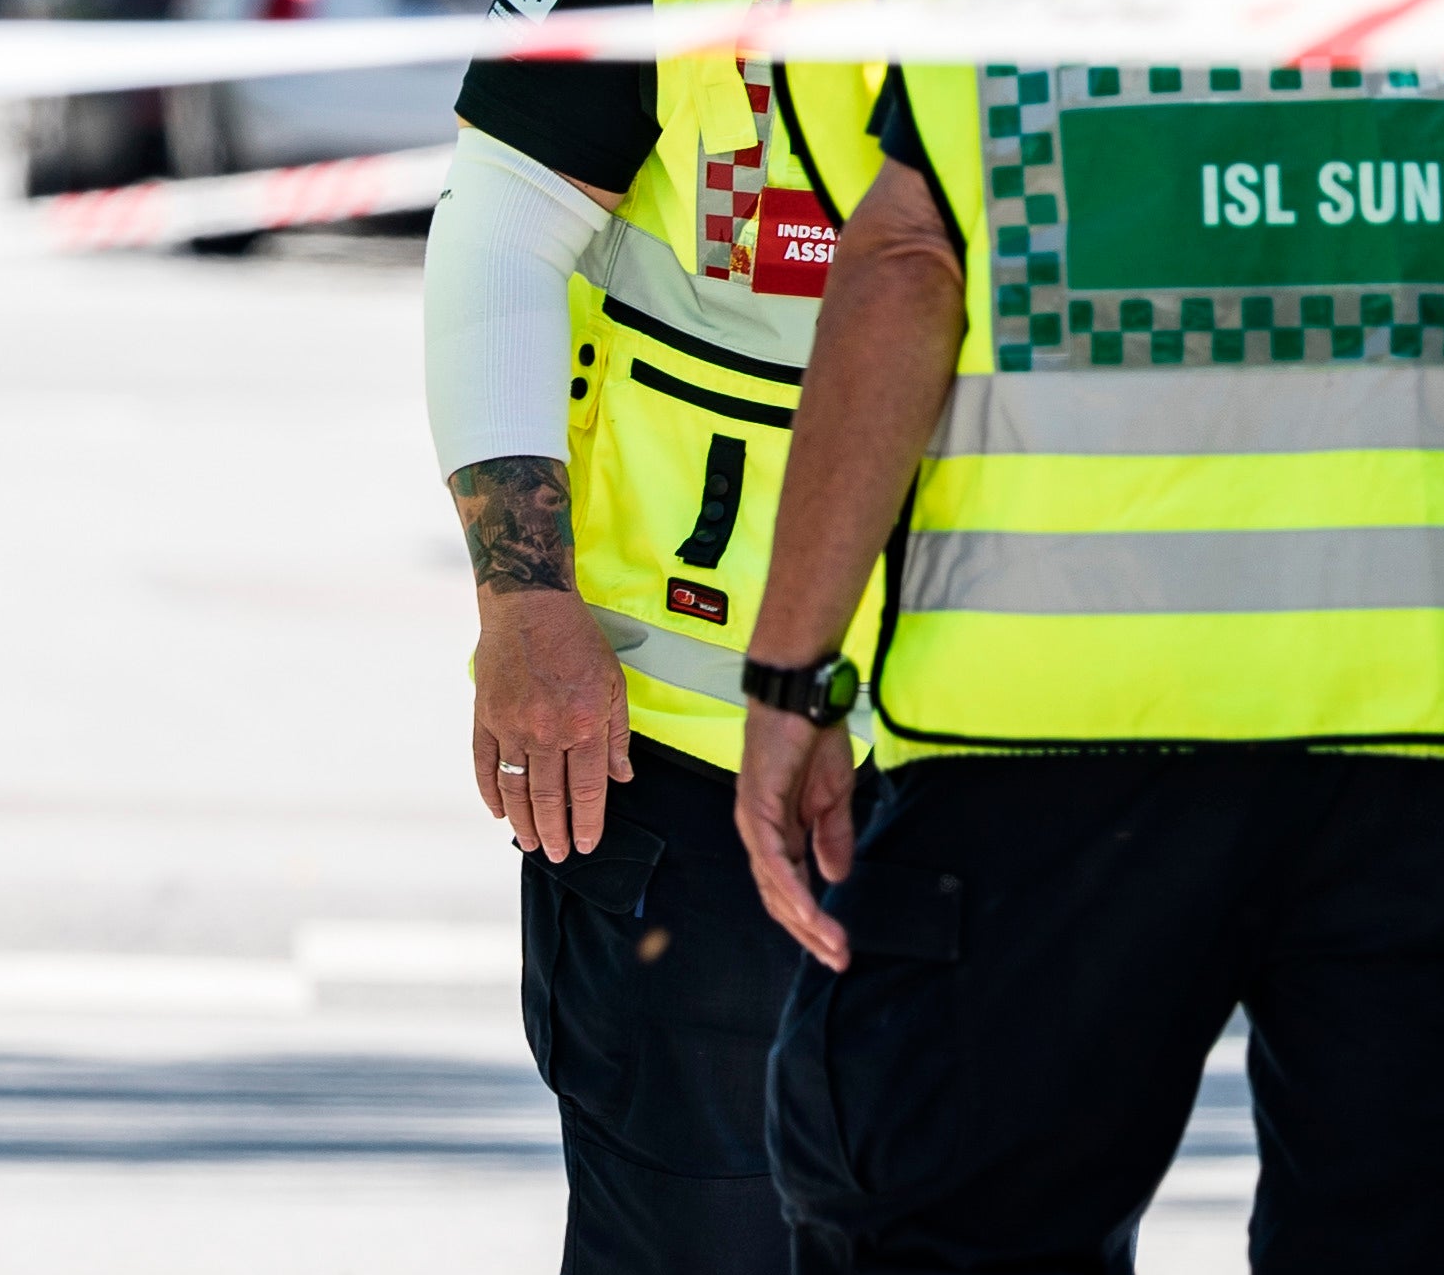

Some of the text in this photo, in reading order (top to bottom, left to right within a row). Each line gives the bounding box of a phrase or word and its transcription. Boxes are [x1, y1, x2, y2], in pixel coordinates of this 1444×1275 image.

[1202, 163, 1296, 226] ISL
[777, 223, 840, 242] INDSA
[783, 240, 836, 264] ASSI
